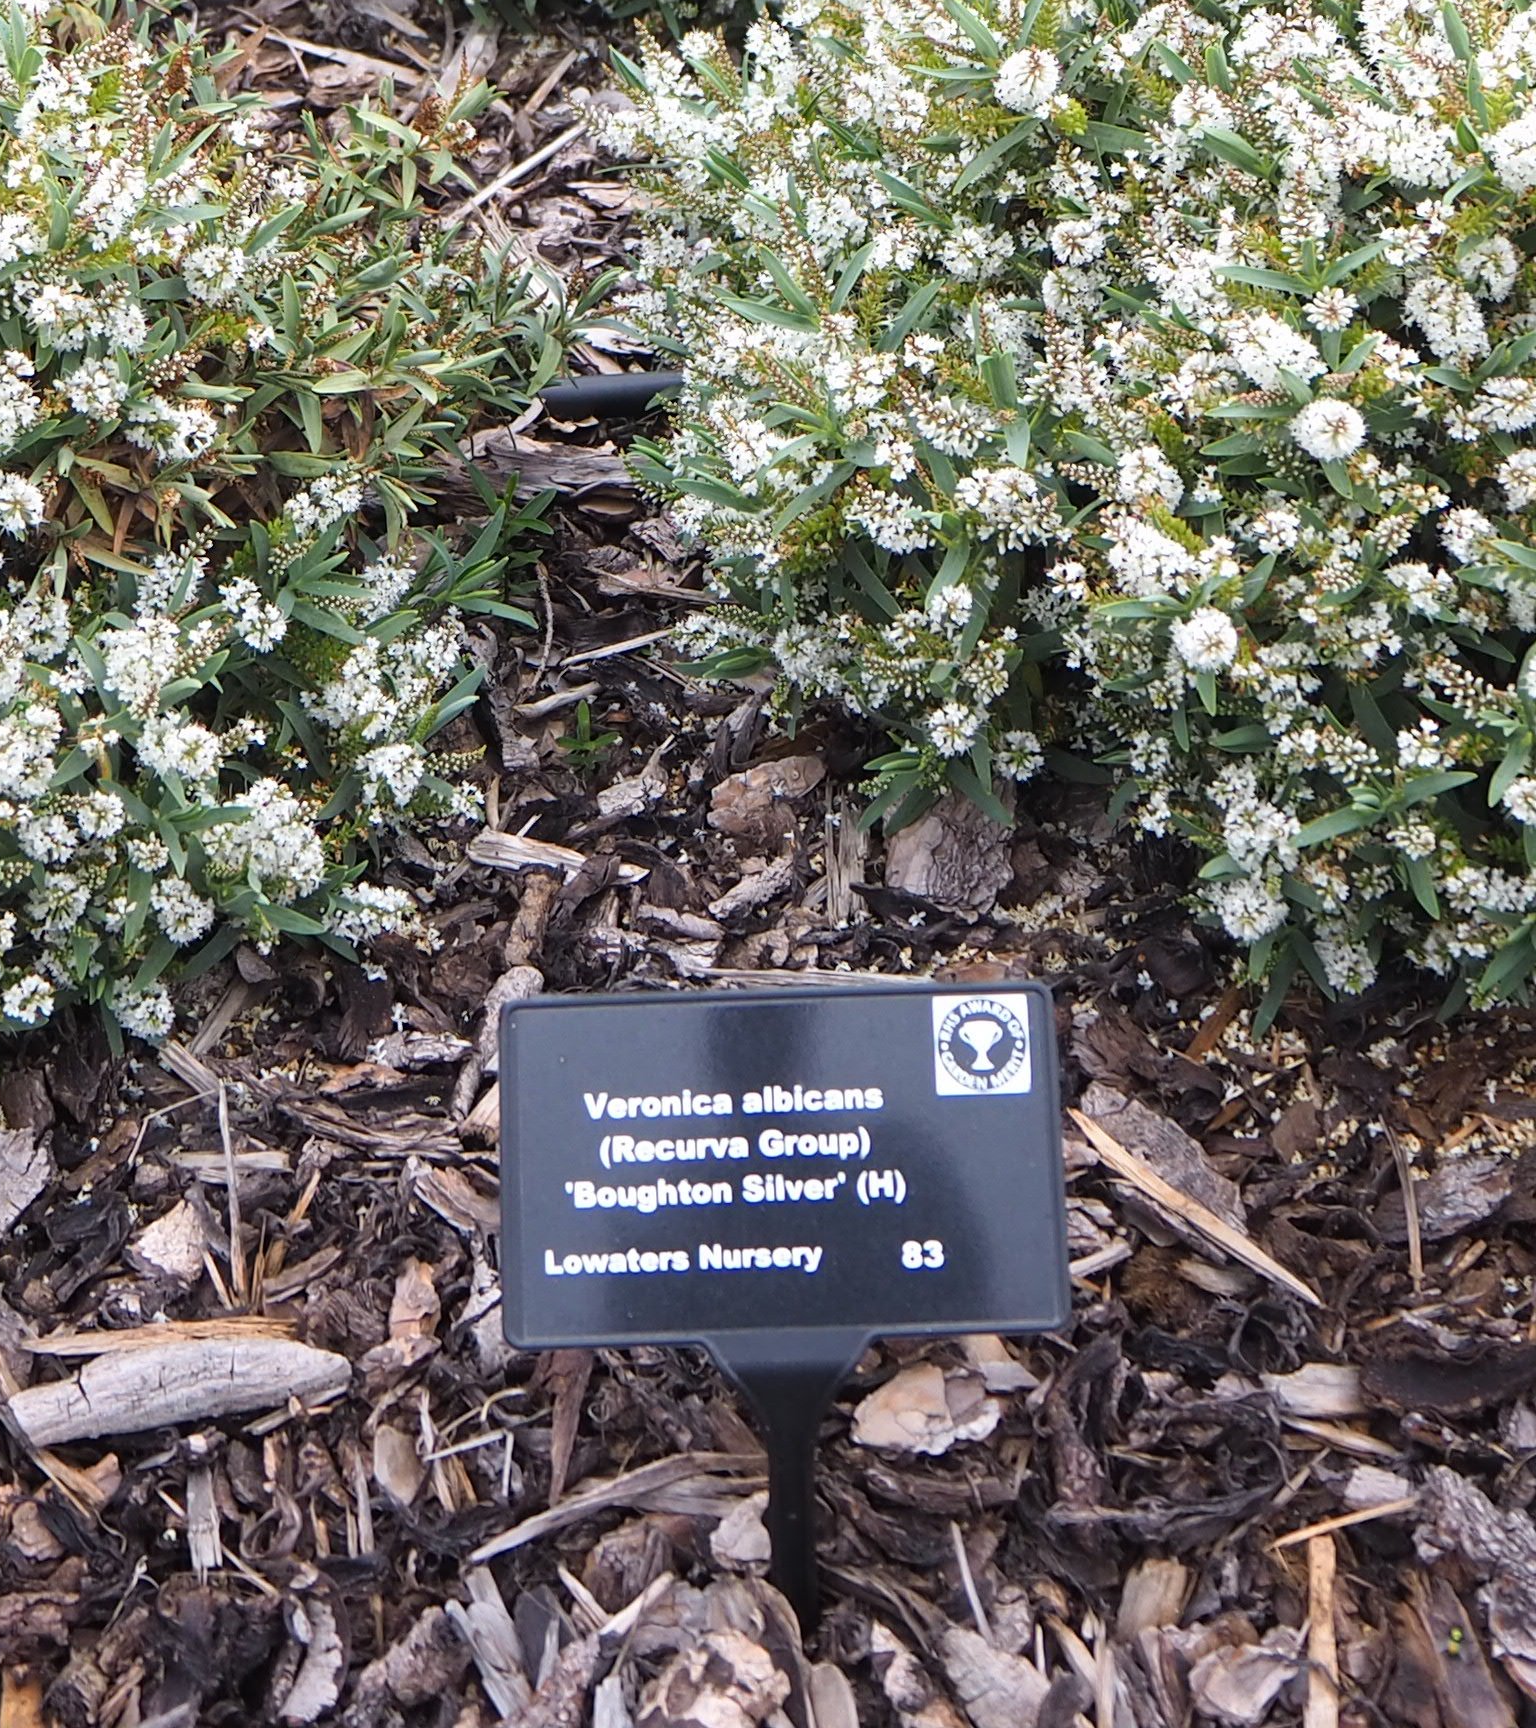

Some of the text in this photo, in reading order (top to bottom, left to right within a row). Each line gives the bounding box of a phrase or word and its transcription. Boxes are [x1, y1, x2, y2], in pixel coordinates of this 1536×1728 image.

[959, 999, 1012, 1023] AWARD
[1007, 1019, 1024, 1039] OF
[584, 1084, 884, 1120] Veronica albicans
[599, 1126, 871, 1169] (Recurva Group)
[565, 1169, 907, 1213] 'Boughton Silver' (H)
[545, 1240, 945, 1276] Lowaters Nursery 83
